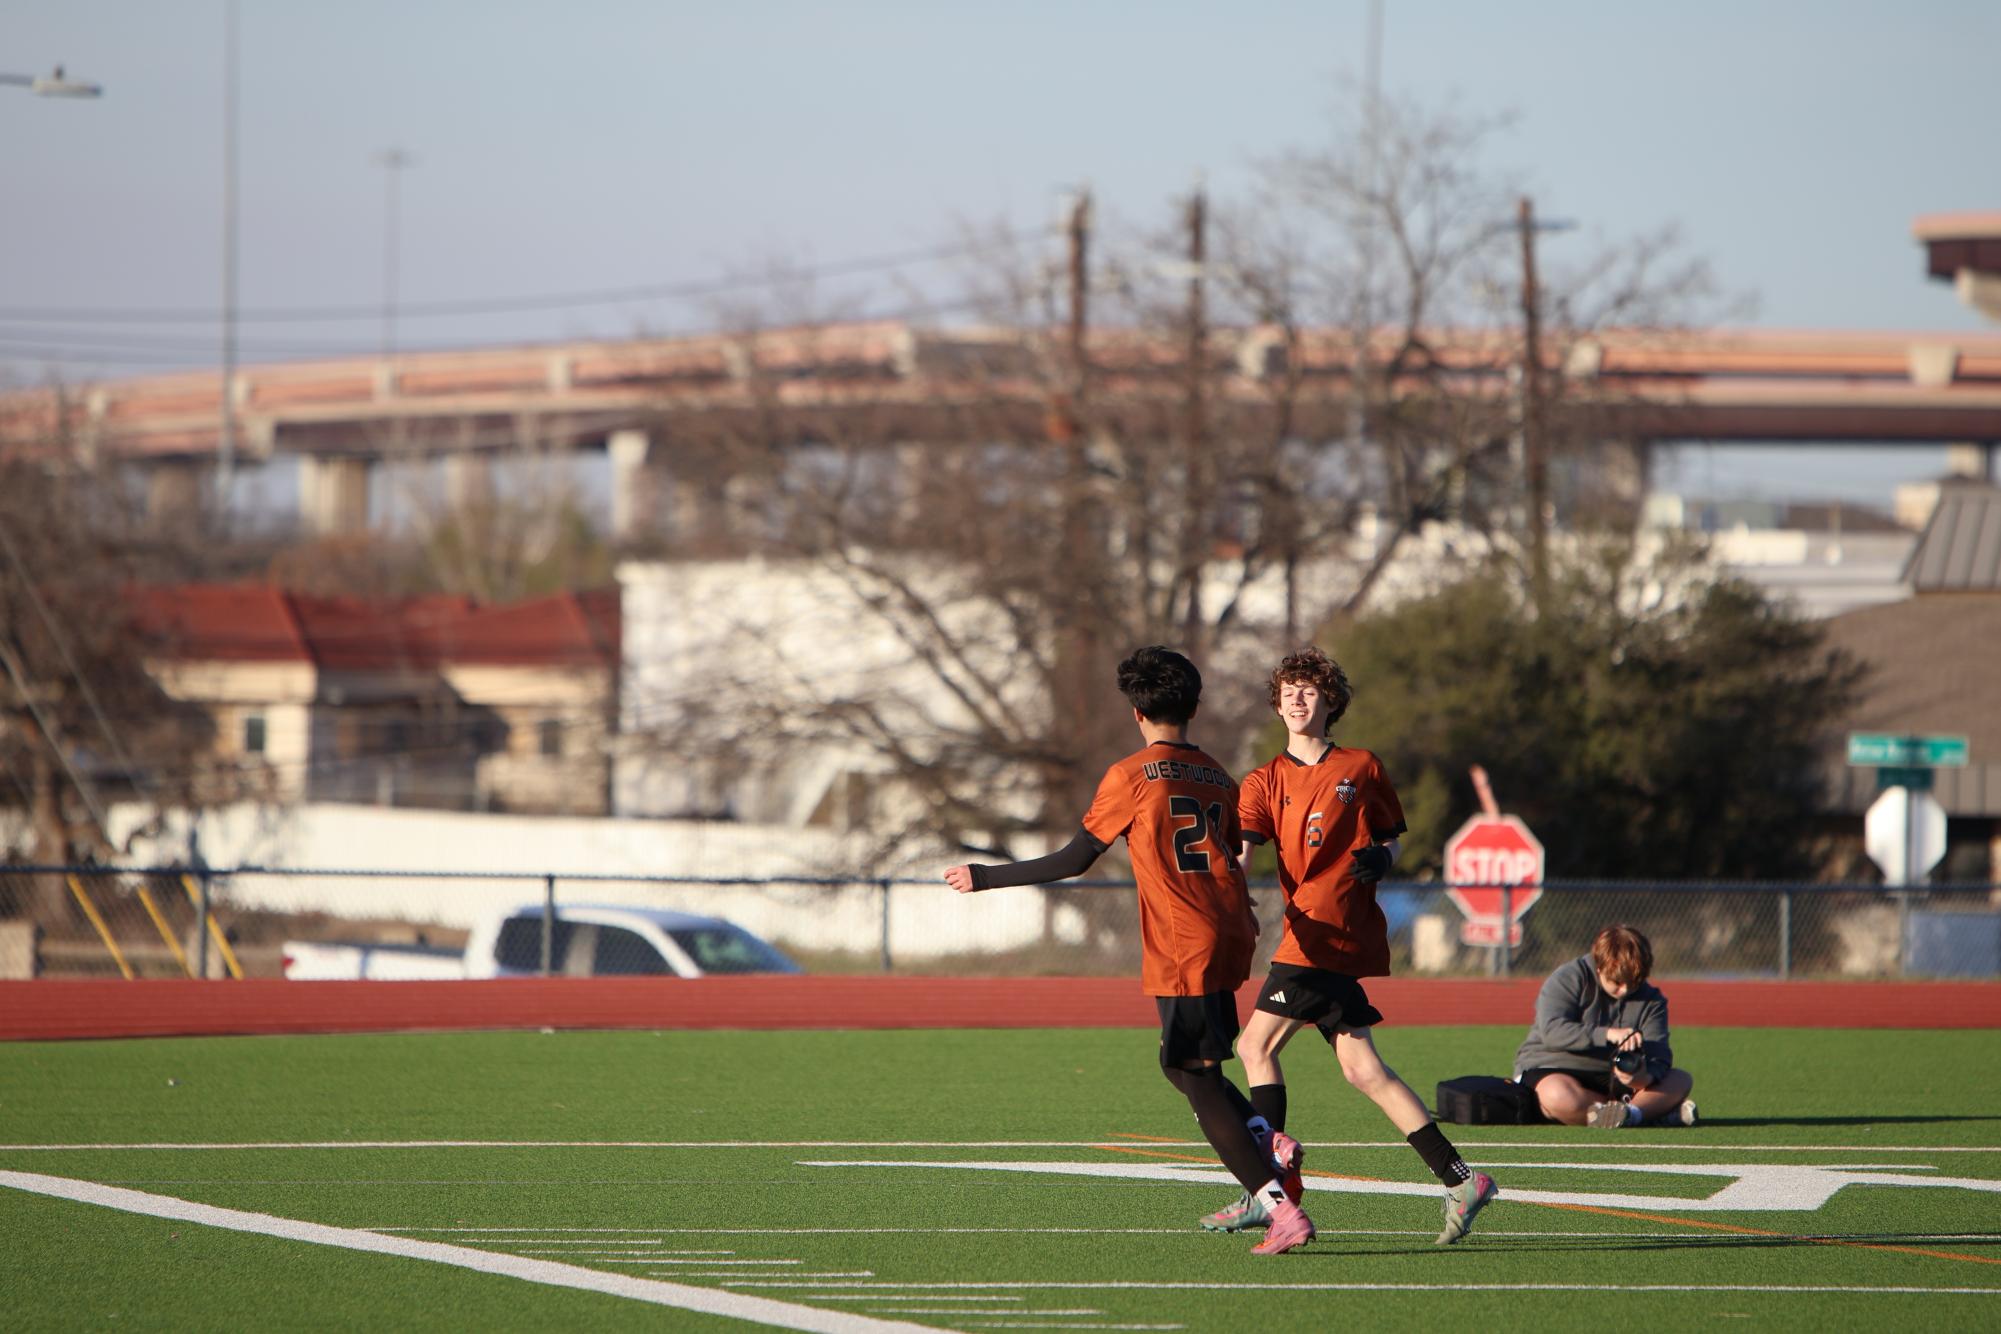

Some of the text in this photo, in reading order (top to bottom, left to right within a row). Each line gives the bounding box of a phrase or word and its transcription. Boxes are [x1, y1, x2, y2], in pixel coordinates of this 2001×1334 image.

[1168, 795, 1237, 874] 21
[1307, 811, 1324, 848] 6
[1455, 847, 1537, 887] STOP
